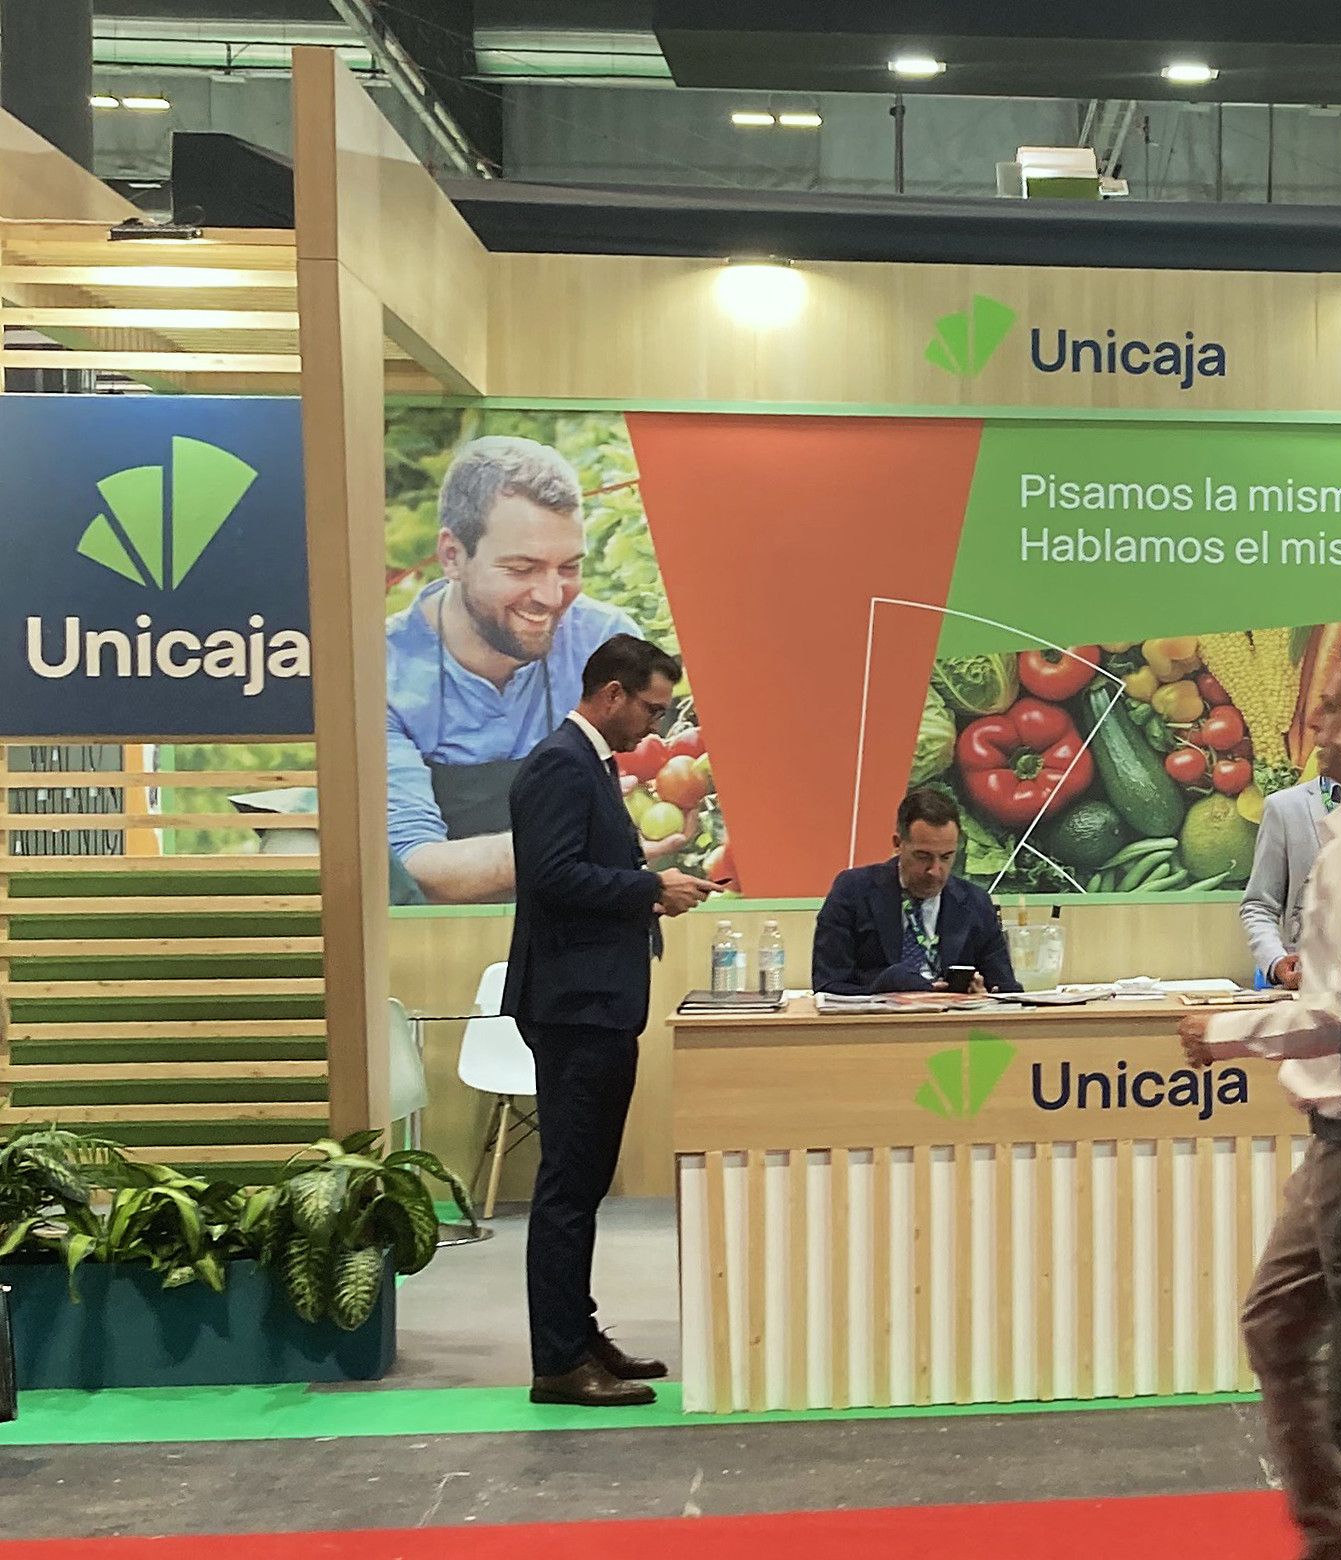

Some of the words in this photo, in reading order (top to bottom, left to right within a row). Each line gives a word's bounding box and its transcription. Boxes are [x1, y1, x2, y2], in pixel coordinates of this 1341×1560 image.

[1030, 327, 1226, 390] Unicaja
[1020, 473, 1194, 512] Pisamos
[1204, 476, 1238, 513] la
[1020, 526, 1225, 565] Hablamos
[1235, 529, 1270, 565] el
[26, 613, 311, 696] Unicaja
[1032, 1059, 1248, 1121] Unicaja
